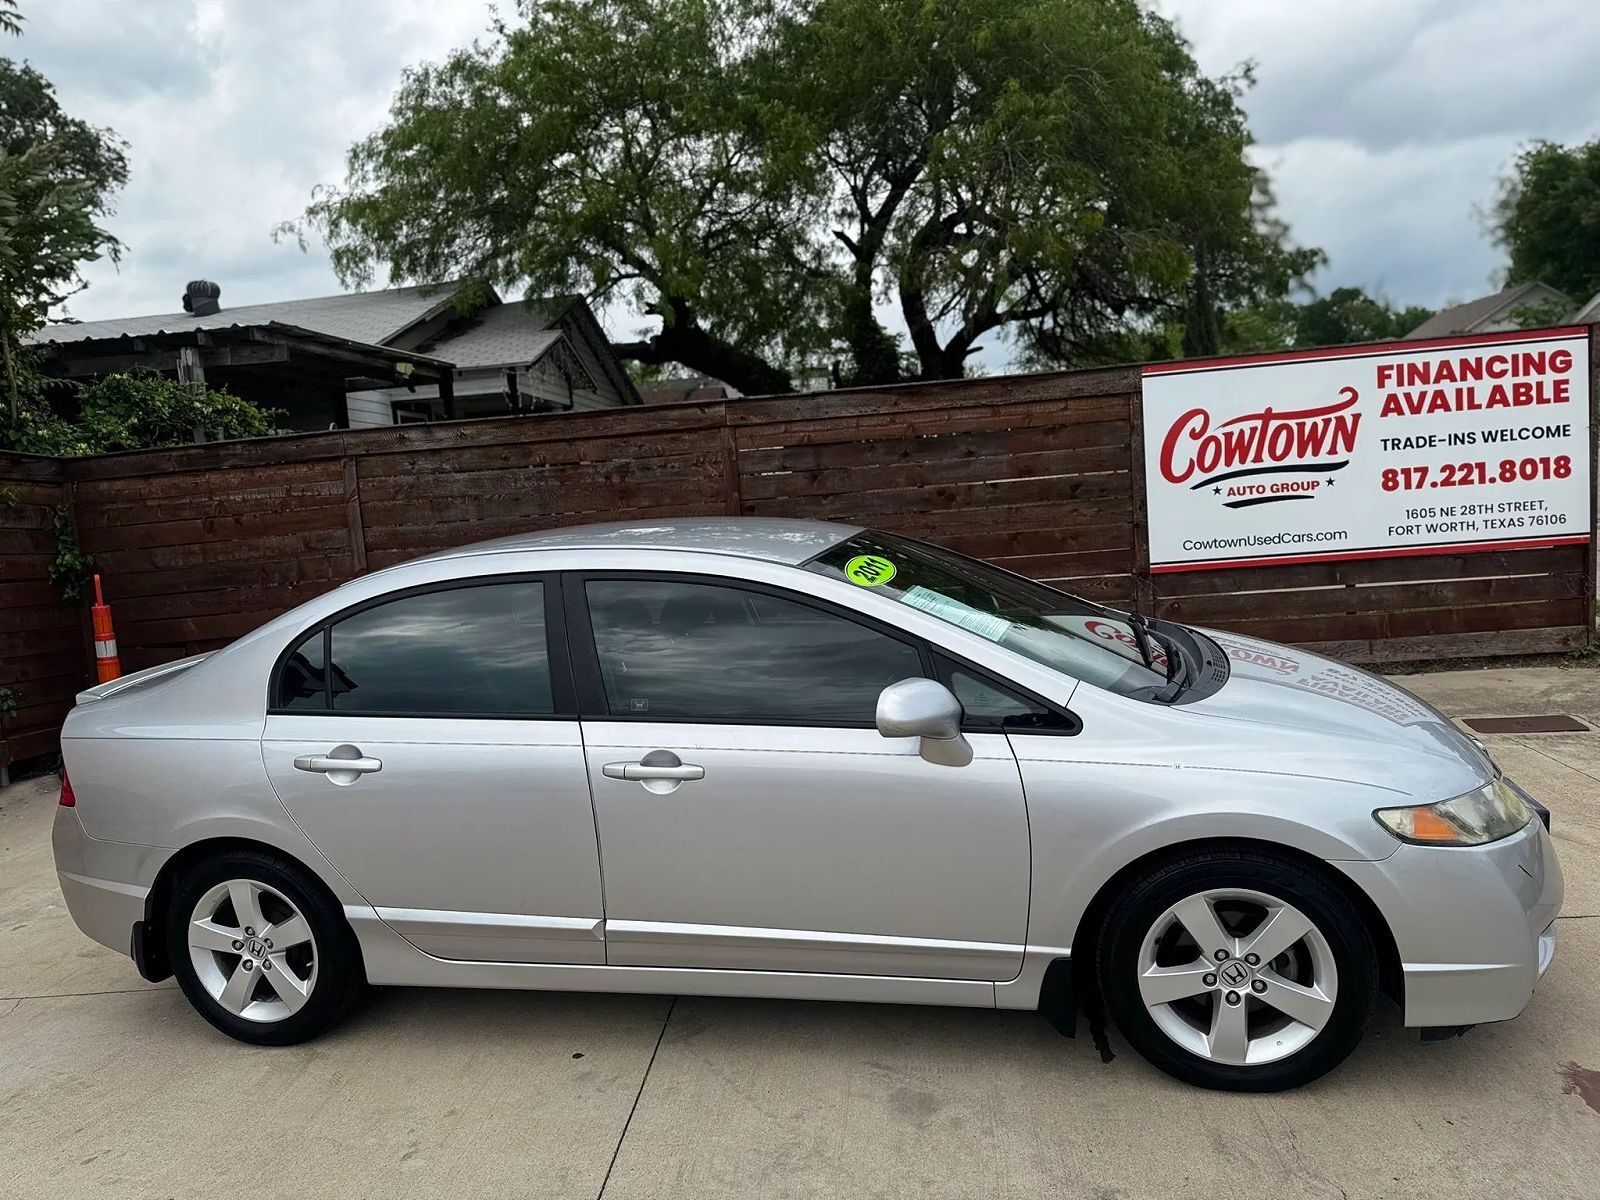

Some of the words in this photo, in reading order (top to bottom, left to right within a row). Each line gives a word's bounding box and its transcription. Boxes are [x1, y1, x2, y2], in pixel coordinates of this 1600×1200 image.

[1377, 349, 1573, 389] FINANCING
[1380, 379, 1570, 418] AVAILABLE
[1380, 432, 1477, 451] TRADE-INS
[1481, 424, 1572, 444] WELCOME
[1381, 455, 1572, 492] 817.221.8018
[1226, 484, 1266, 497] AUTO
[1270, 480, 1321, 493] GROUP
[1405, 507, 1437, 520] 1605
[1440, 506, 1457, 518] NE
[1460, 503, 1494, 516] 28TH
[1497, 499, 1549, 513] STREET,
[1388, 524, 1422, 536] FORT
[1426, 520, 1480, 534] WORTH,
[1482, 517, 1525, 530] TEXAS
[1528, 513, 1567, 527] 76106
[1182, 529, 1348, 551] CowtownUsedCars.com
[853, 557, 889, 583] 2011
